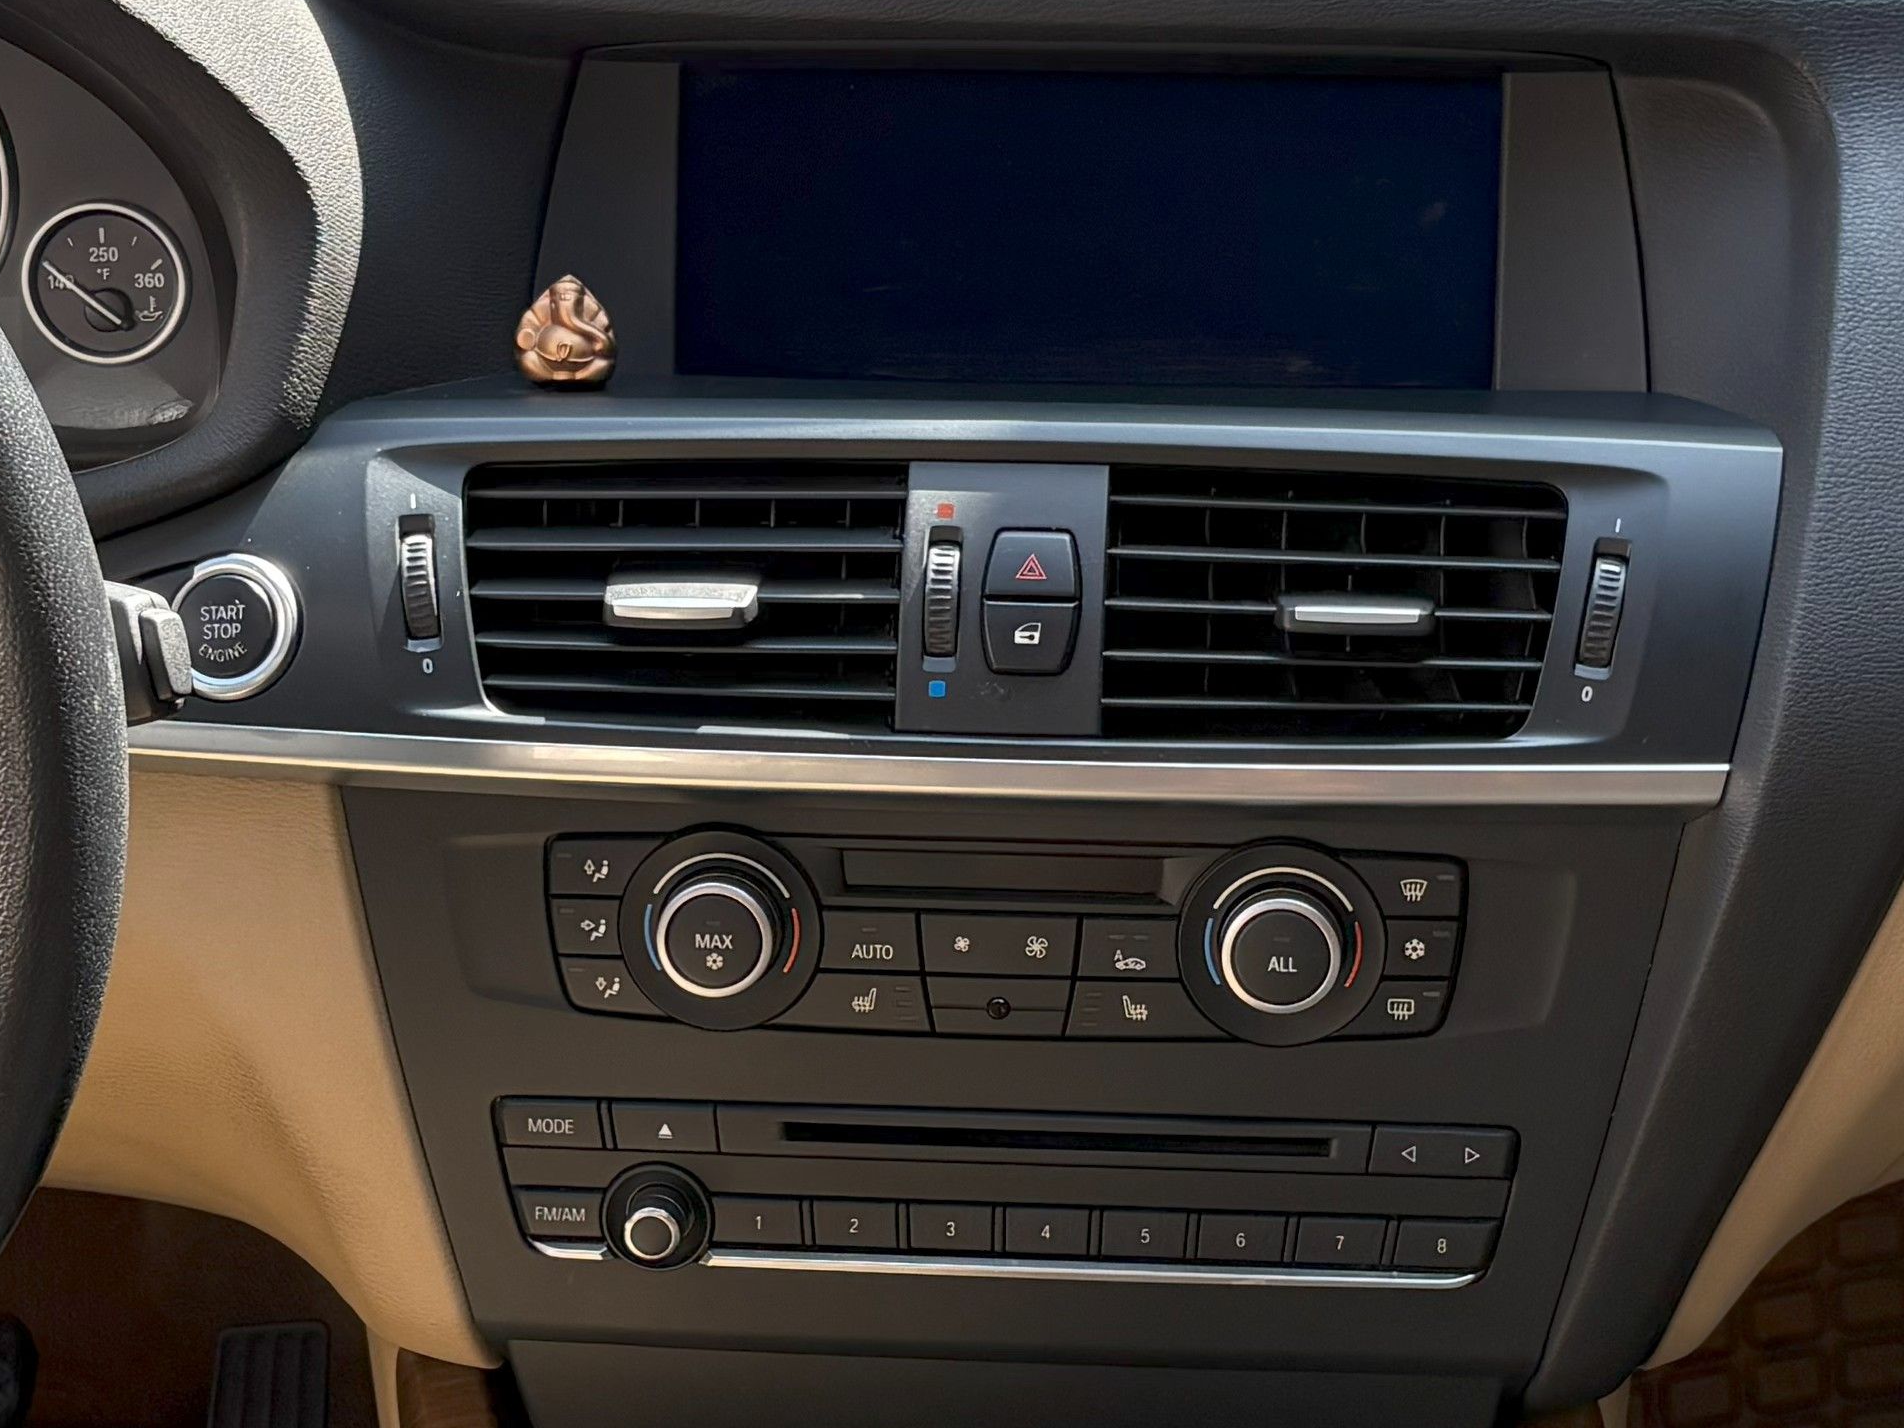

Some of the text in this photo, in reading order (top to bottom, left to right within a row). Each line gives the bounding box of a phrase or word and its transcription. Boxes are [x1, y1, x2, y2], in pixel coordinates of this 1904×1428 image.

[89, 247, 118, 262] 250
[134, 273, 165, 288] 360
[200, 603, 245, 622] START
[203, 623, 241, 640] STOP
[198, 641, 247, 662] ENGINE
[695, 933, 733, 950] MAX
[852, 943, 894, 961] AUTO
[1267, 956, 1297, 973] ALL
[528, 1117, 574, 1135] MODE
[535, 1206, 586, 1223] FM/AM
[755, 1216, 763, 1230] 1
[849, 1219, 859, 1234] 2
[946, 1222, 955, 1237] 3
[1041, 1225, 1051, 1240] 4
[1141, 1229, 1150, 1244] 5
[1236, 1233, 1245, 1248] 6
[1336, 1236, 1345, 1251] 7
[1437, 1238, 1447, 1254] 8
